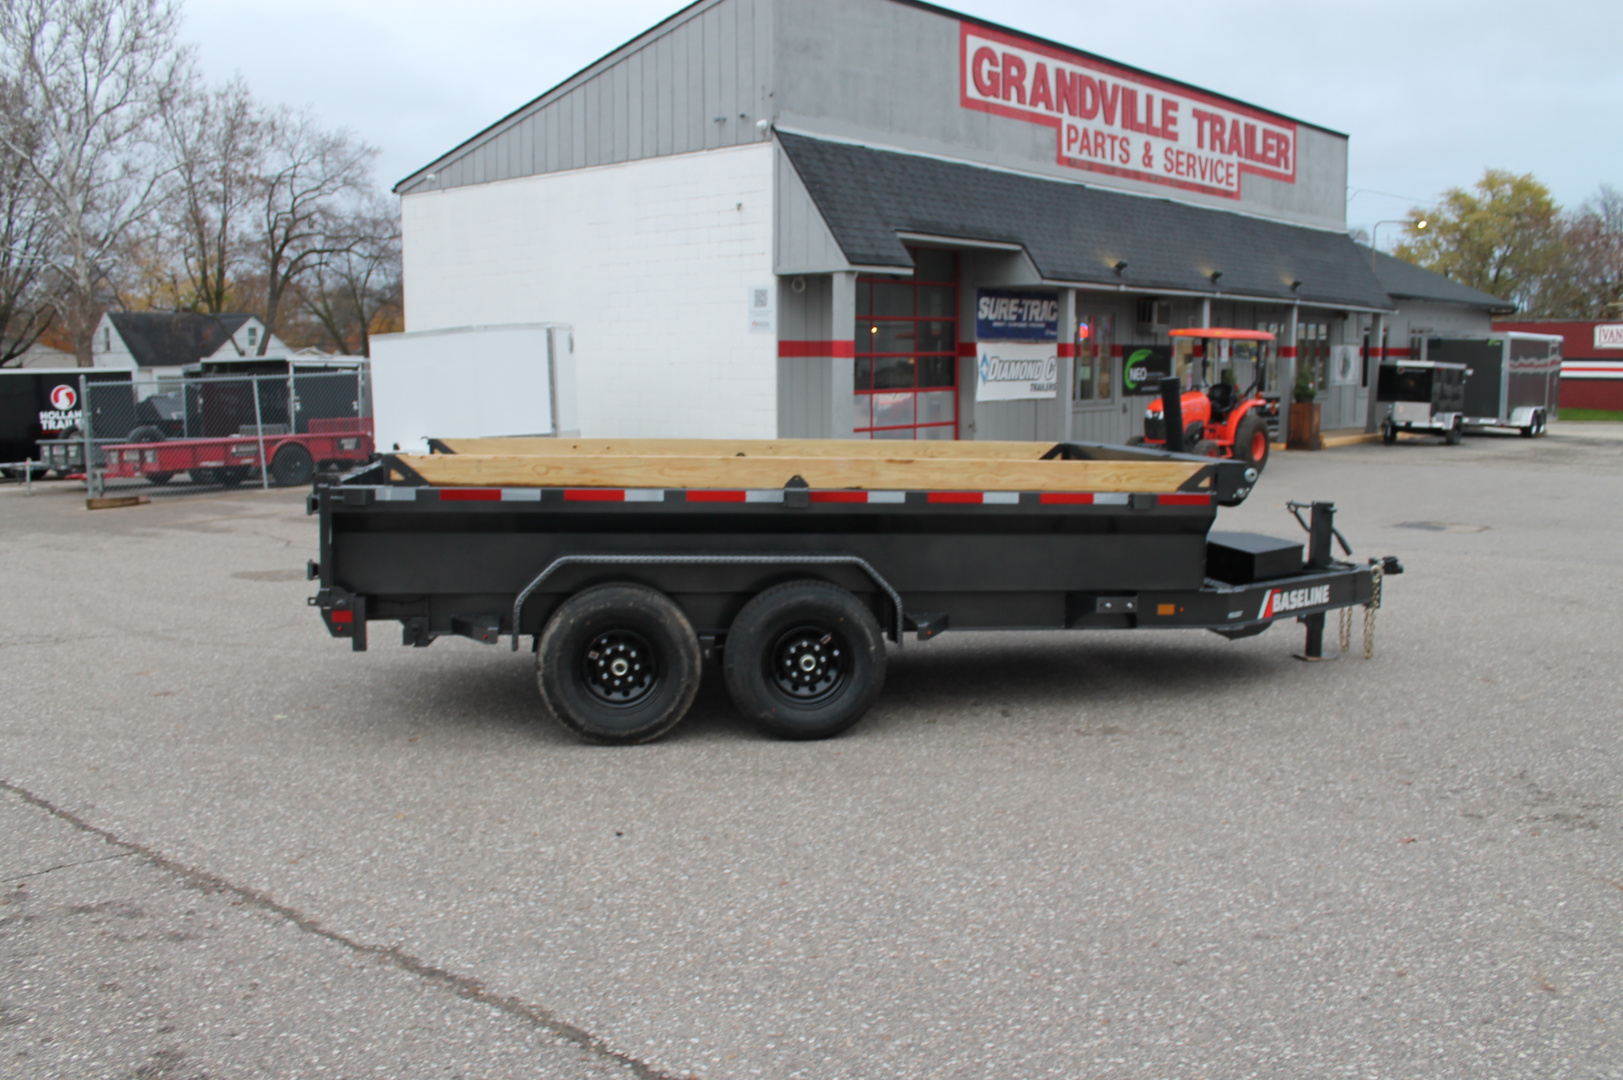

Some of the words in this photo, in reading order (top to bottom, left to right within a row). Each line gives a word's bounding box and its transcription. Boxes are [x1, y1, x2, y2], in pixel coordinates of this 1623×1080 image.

[972, 46, 1179, 142] GRANDVILLE
[1192, 108, 1291, 170] TRAILER
[1066, 124, 1130, 164] PARTS
[1142, 142, 1154, 168] &
[1163, 147, 1235, 187] SERVICE
[978, 296, 1058, 322] SURE-TRAC
[987, 356, 1043, 382] DIAMOND
[1045, 356, 1057, 381] C
[1129, 366, 1147, 381] NEO
[1030, 383, 1057, 392] TRAILERS
[39, 410, 83, 420] HOLLAN
[1272, 584, 1330, 613] BASELINE
